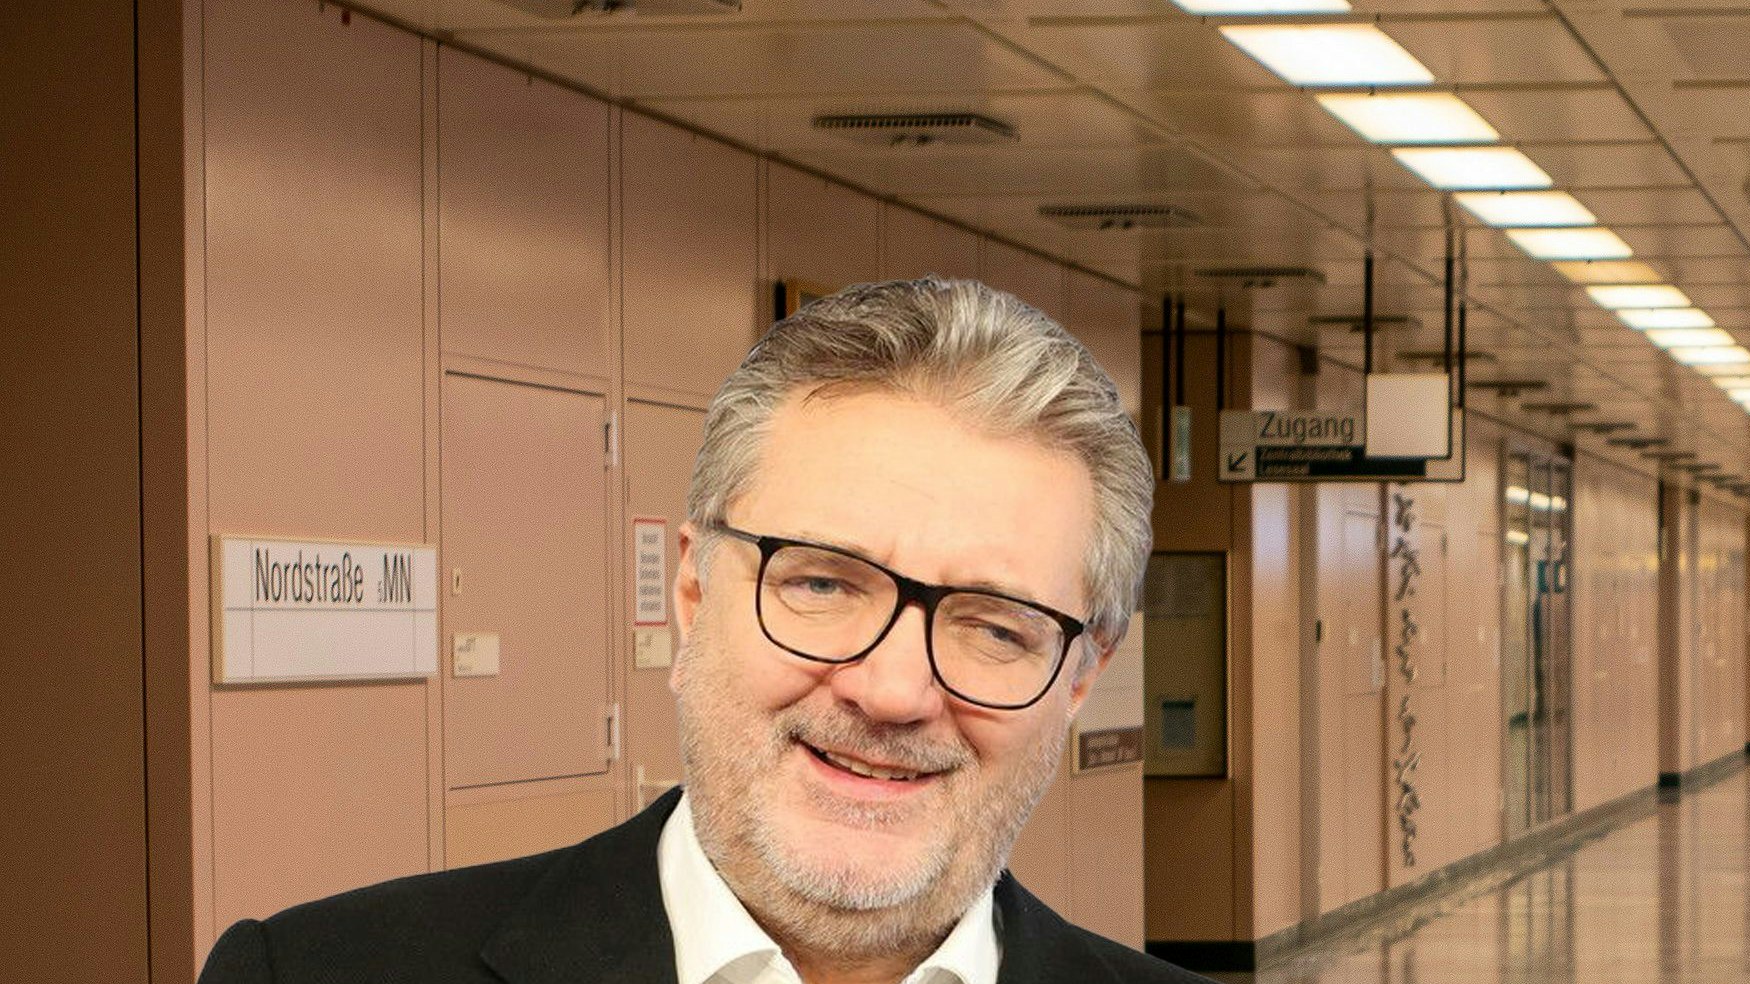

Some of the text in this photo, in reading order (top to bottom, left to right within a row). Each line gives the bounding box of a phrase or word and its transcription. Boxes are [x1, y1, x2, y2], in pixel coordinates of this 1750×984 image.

[1259, 411, 1355, 442] Zugang
[255, 547, 365, 604] Nordstraße
[382, 552, 412, 603] MN
